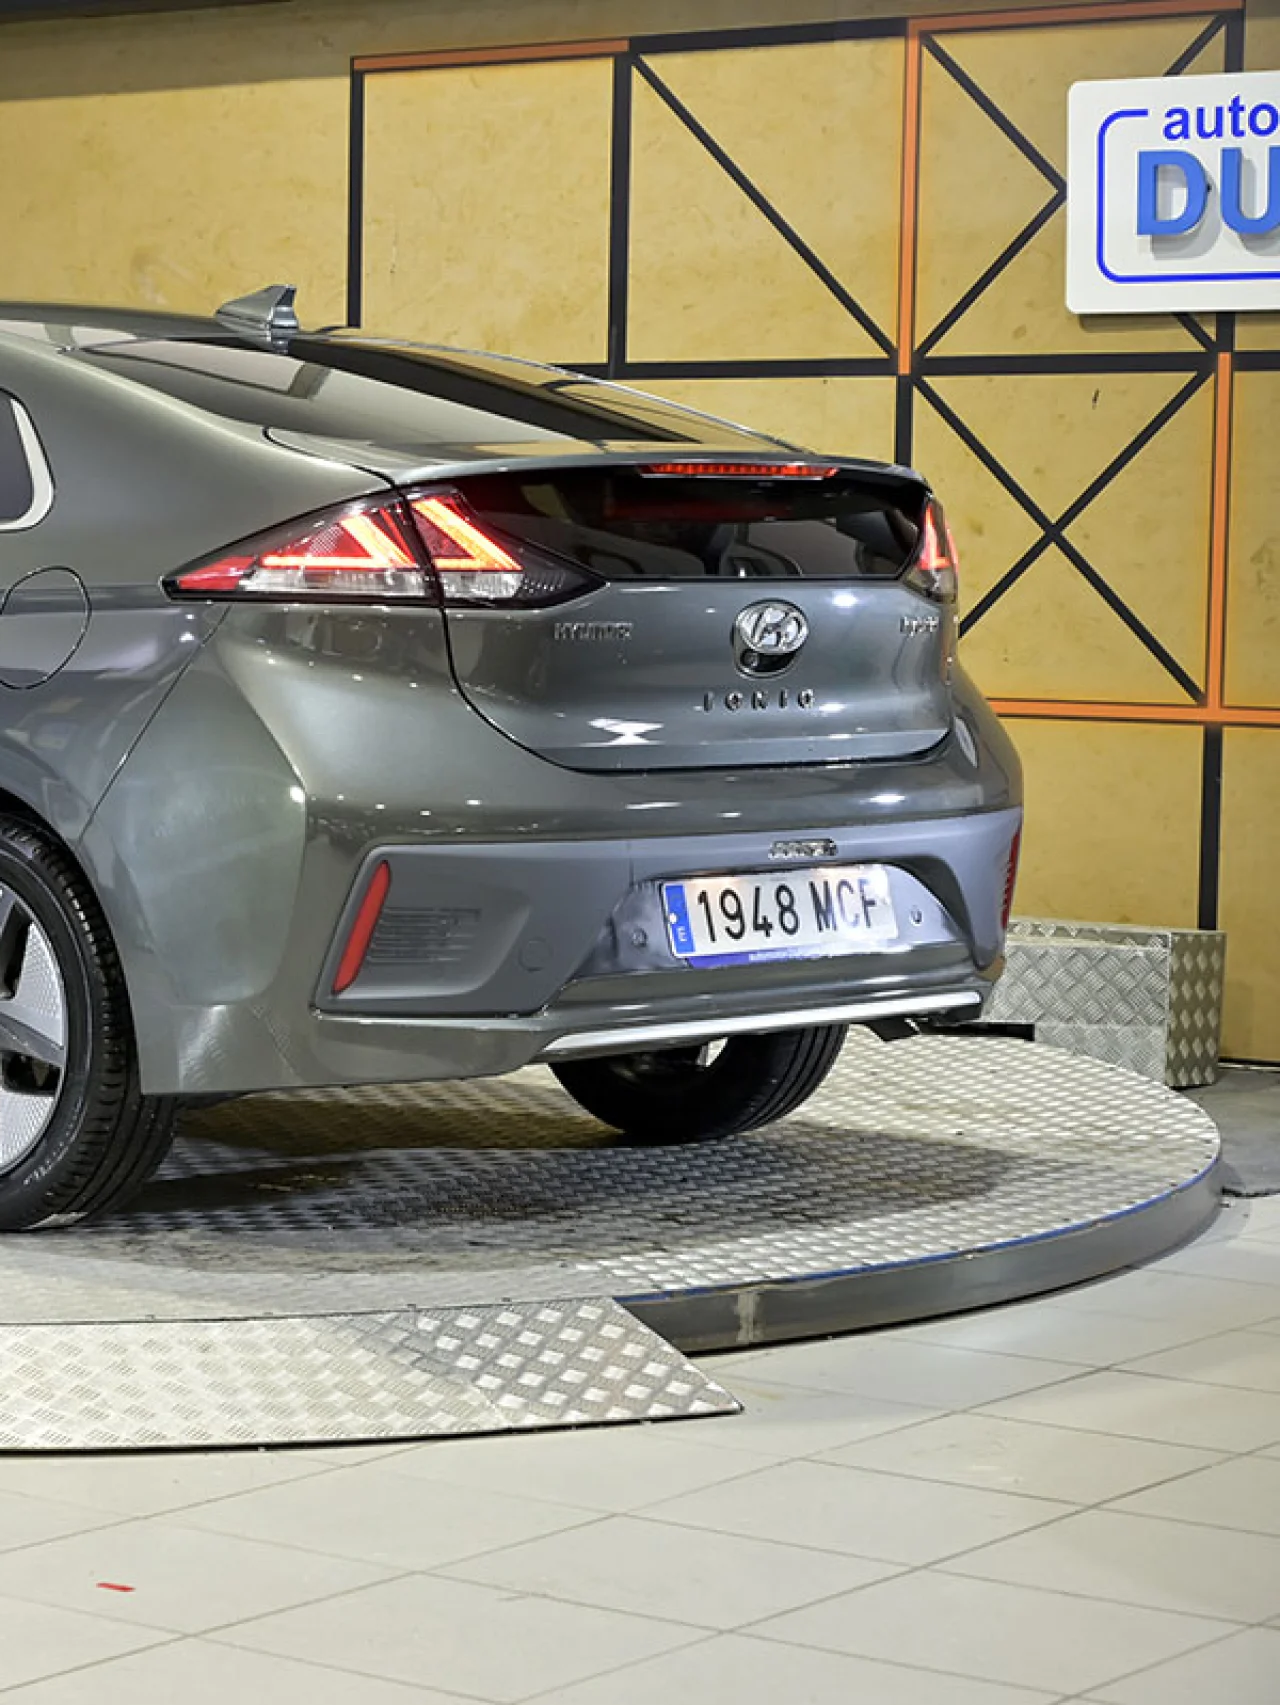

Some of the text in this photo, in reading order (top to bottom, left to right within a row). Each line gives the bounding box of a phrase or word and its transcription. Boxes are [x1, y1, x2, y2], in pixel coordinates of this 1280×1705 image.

[1161, 94, 1280, 141] auto
[1136, 146, 1280, 236] DU
[676, 926, 688, 942] E
[697, 878, 877, 943] 1948 MCF
